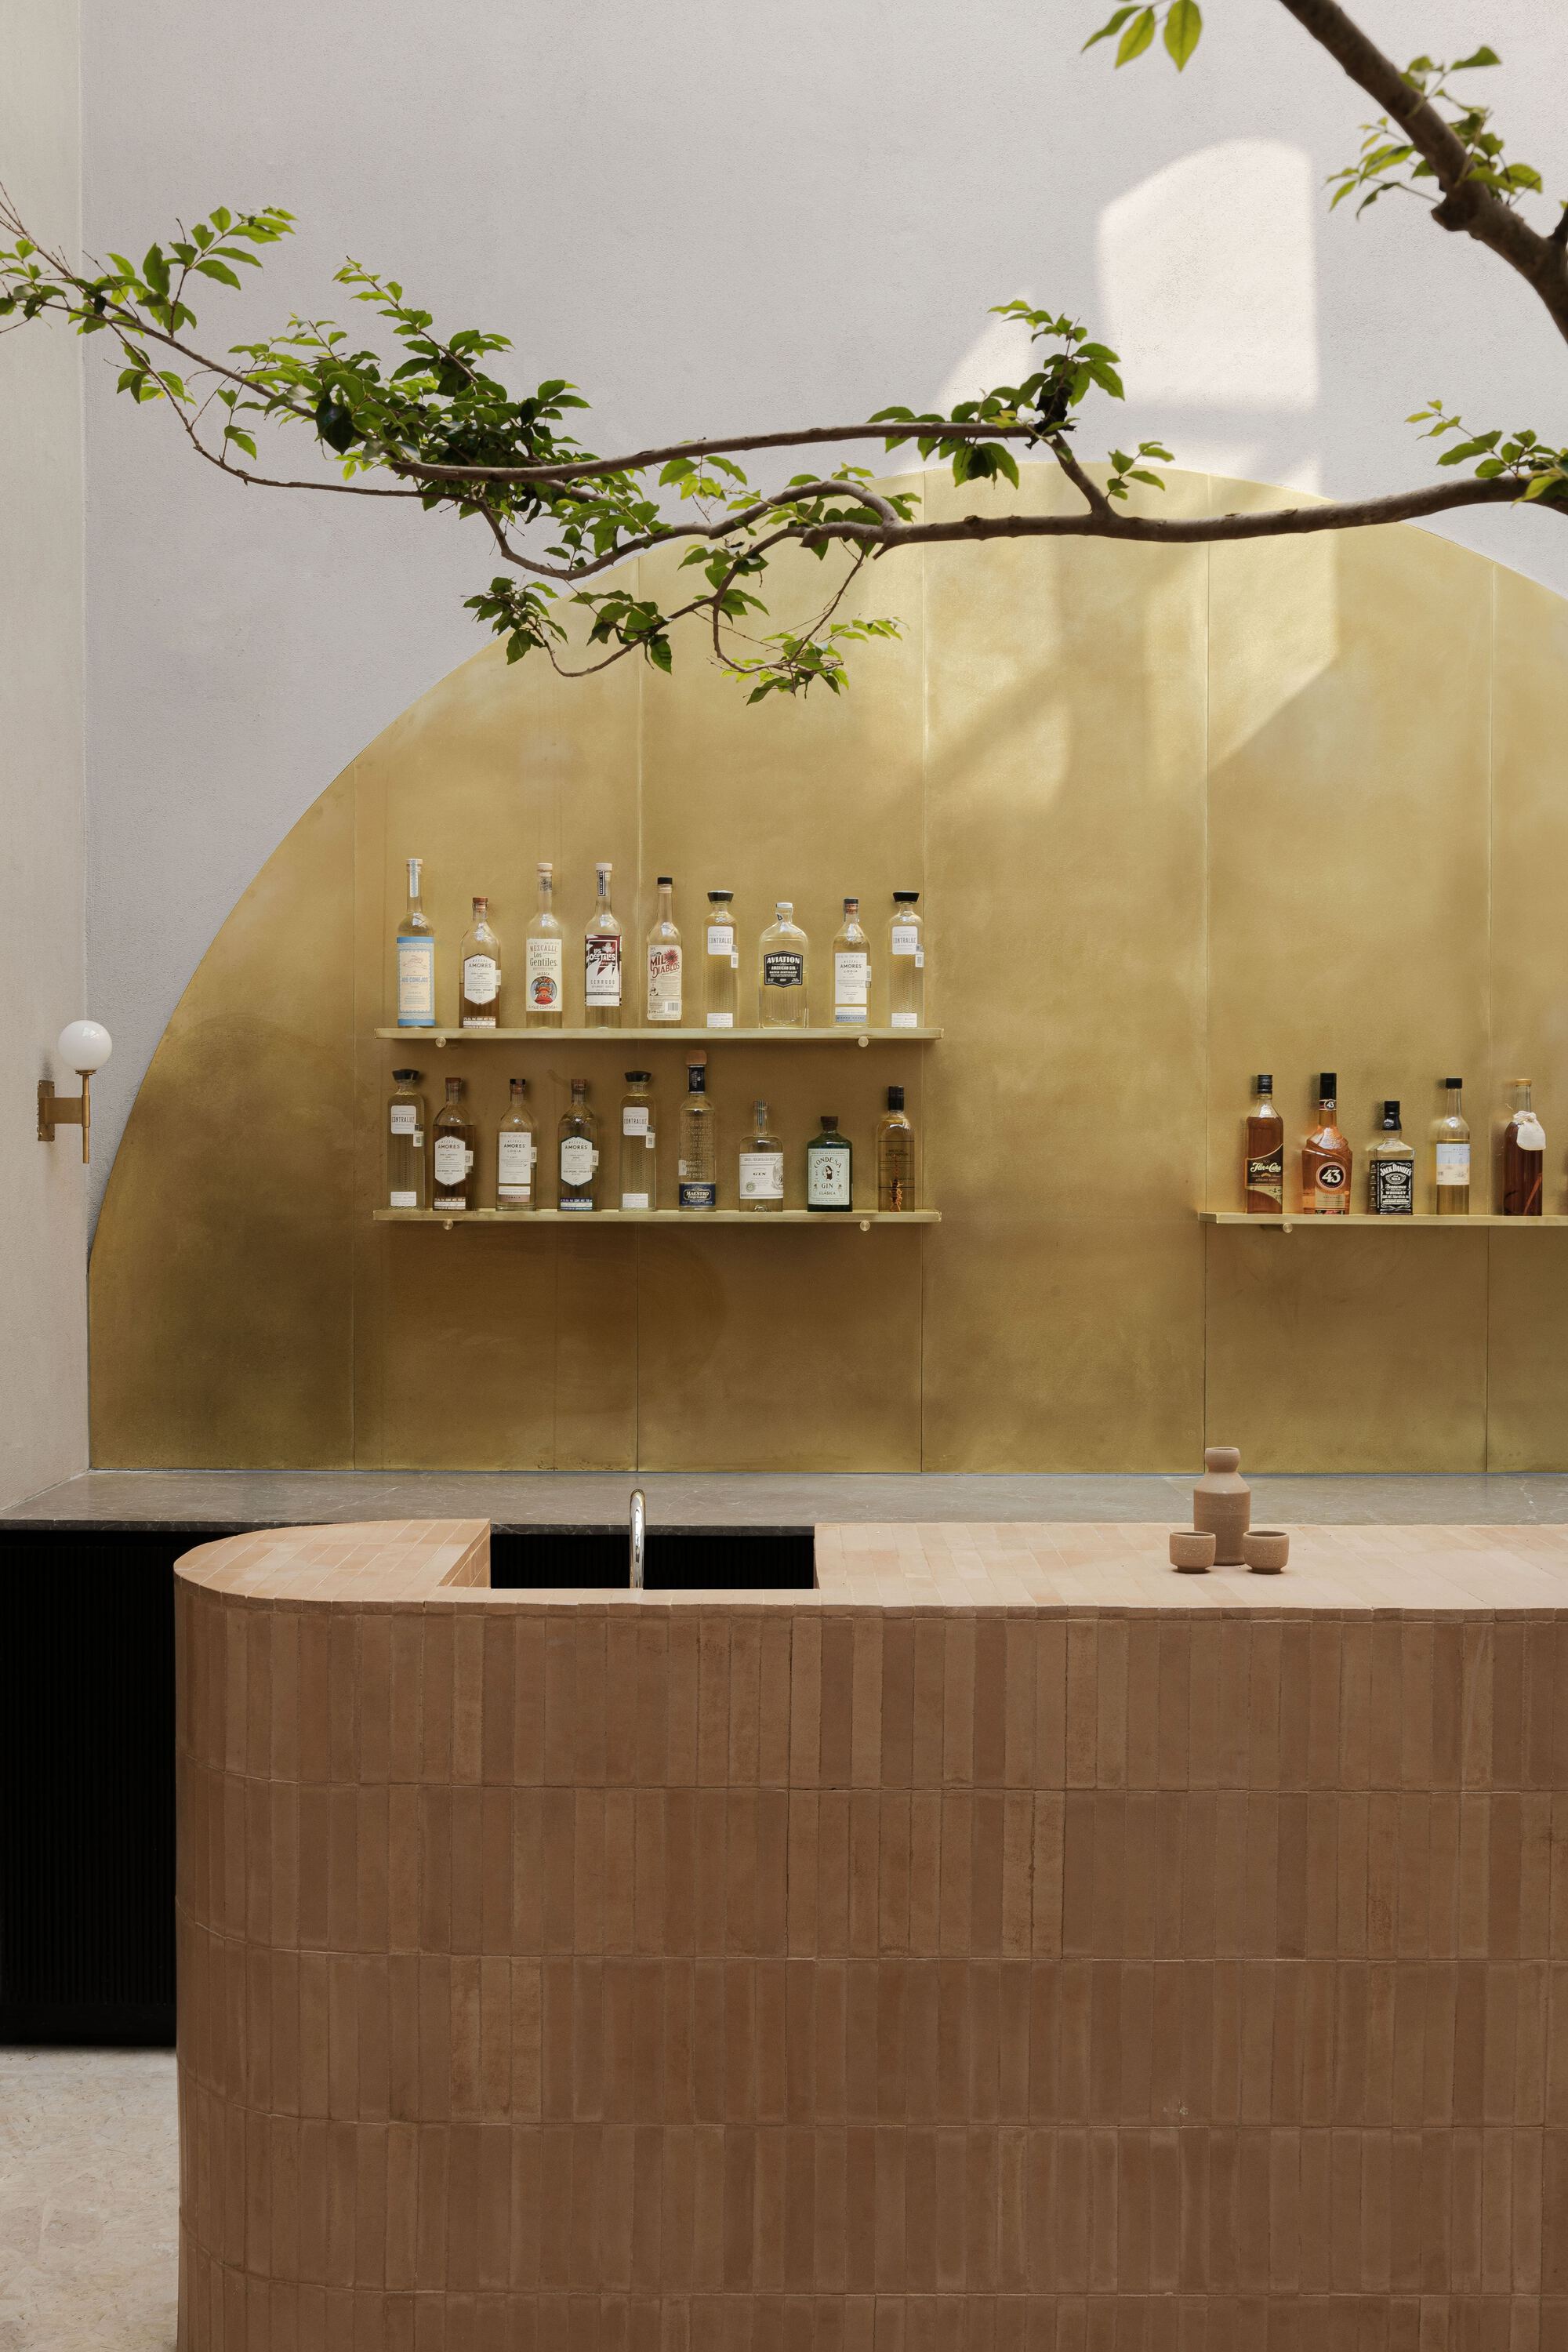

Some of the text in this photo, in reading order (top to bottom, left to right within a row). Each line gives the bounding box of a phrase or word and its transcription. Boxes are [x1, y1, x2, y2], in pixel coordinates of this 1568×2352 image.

[651, 955, 666, 972] MIL
[652, 962, 681, 978] DIABLOS
[814, 1156, 842, 1169] CONDESA
[1321, 1169, 1341, 1183] 43
[1380, 1165, 1393, 1177] JACK
